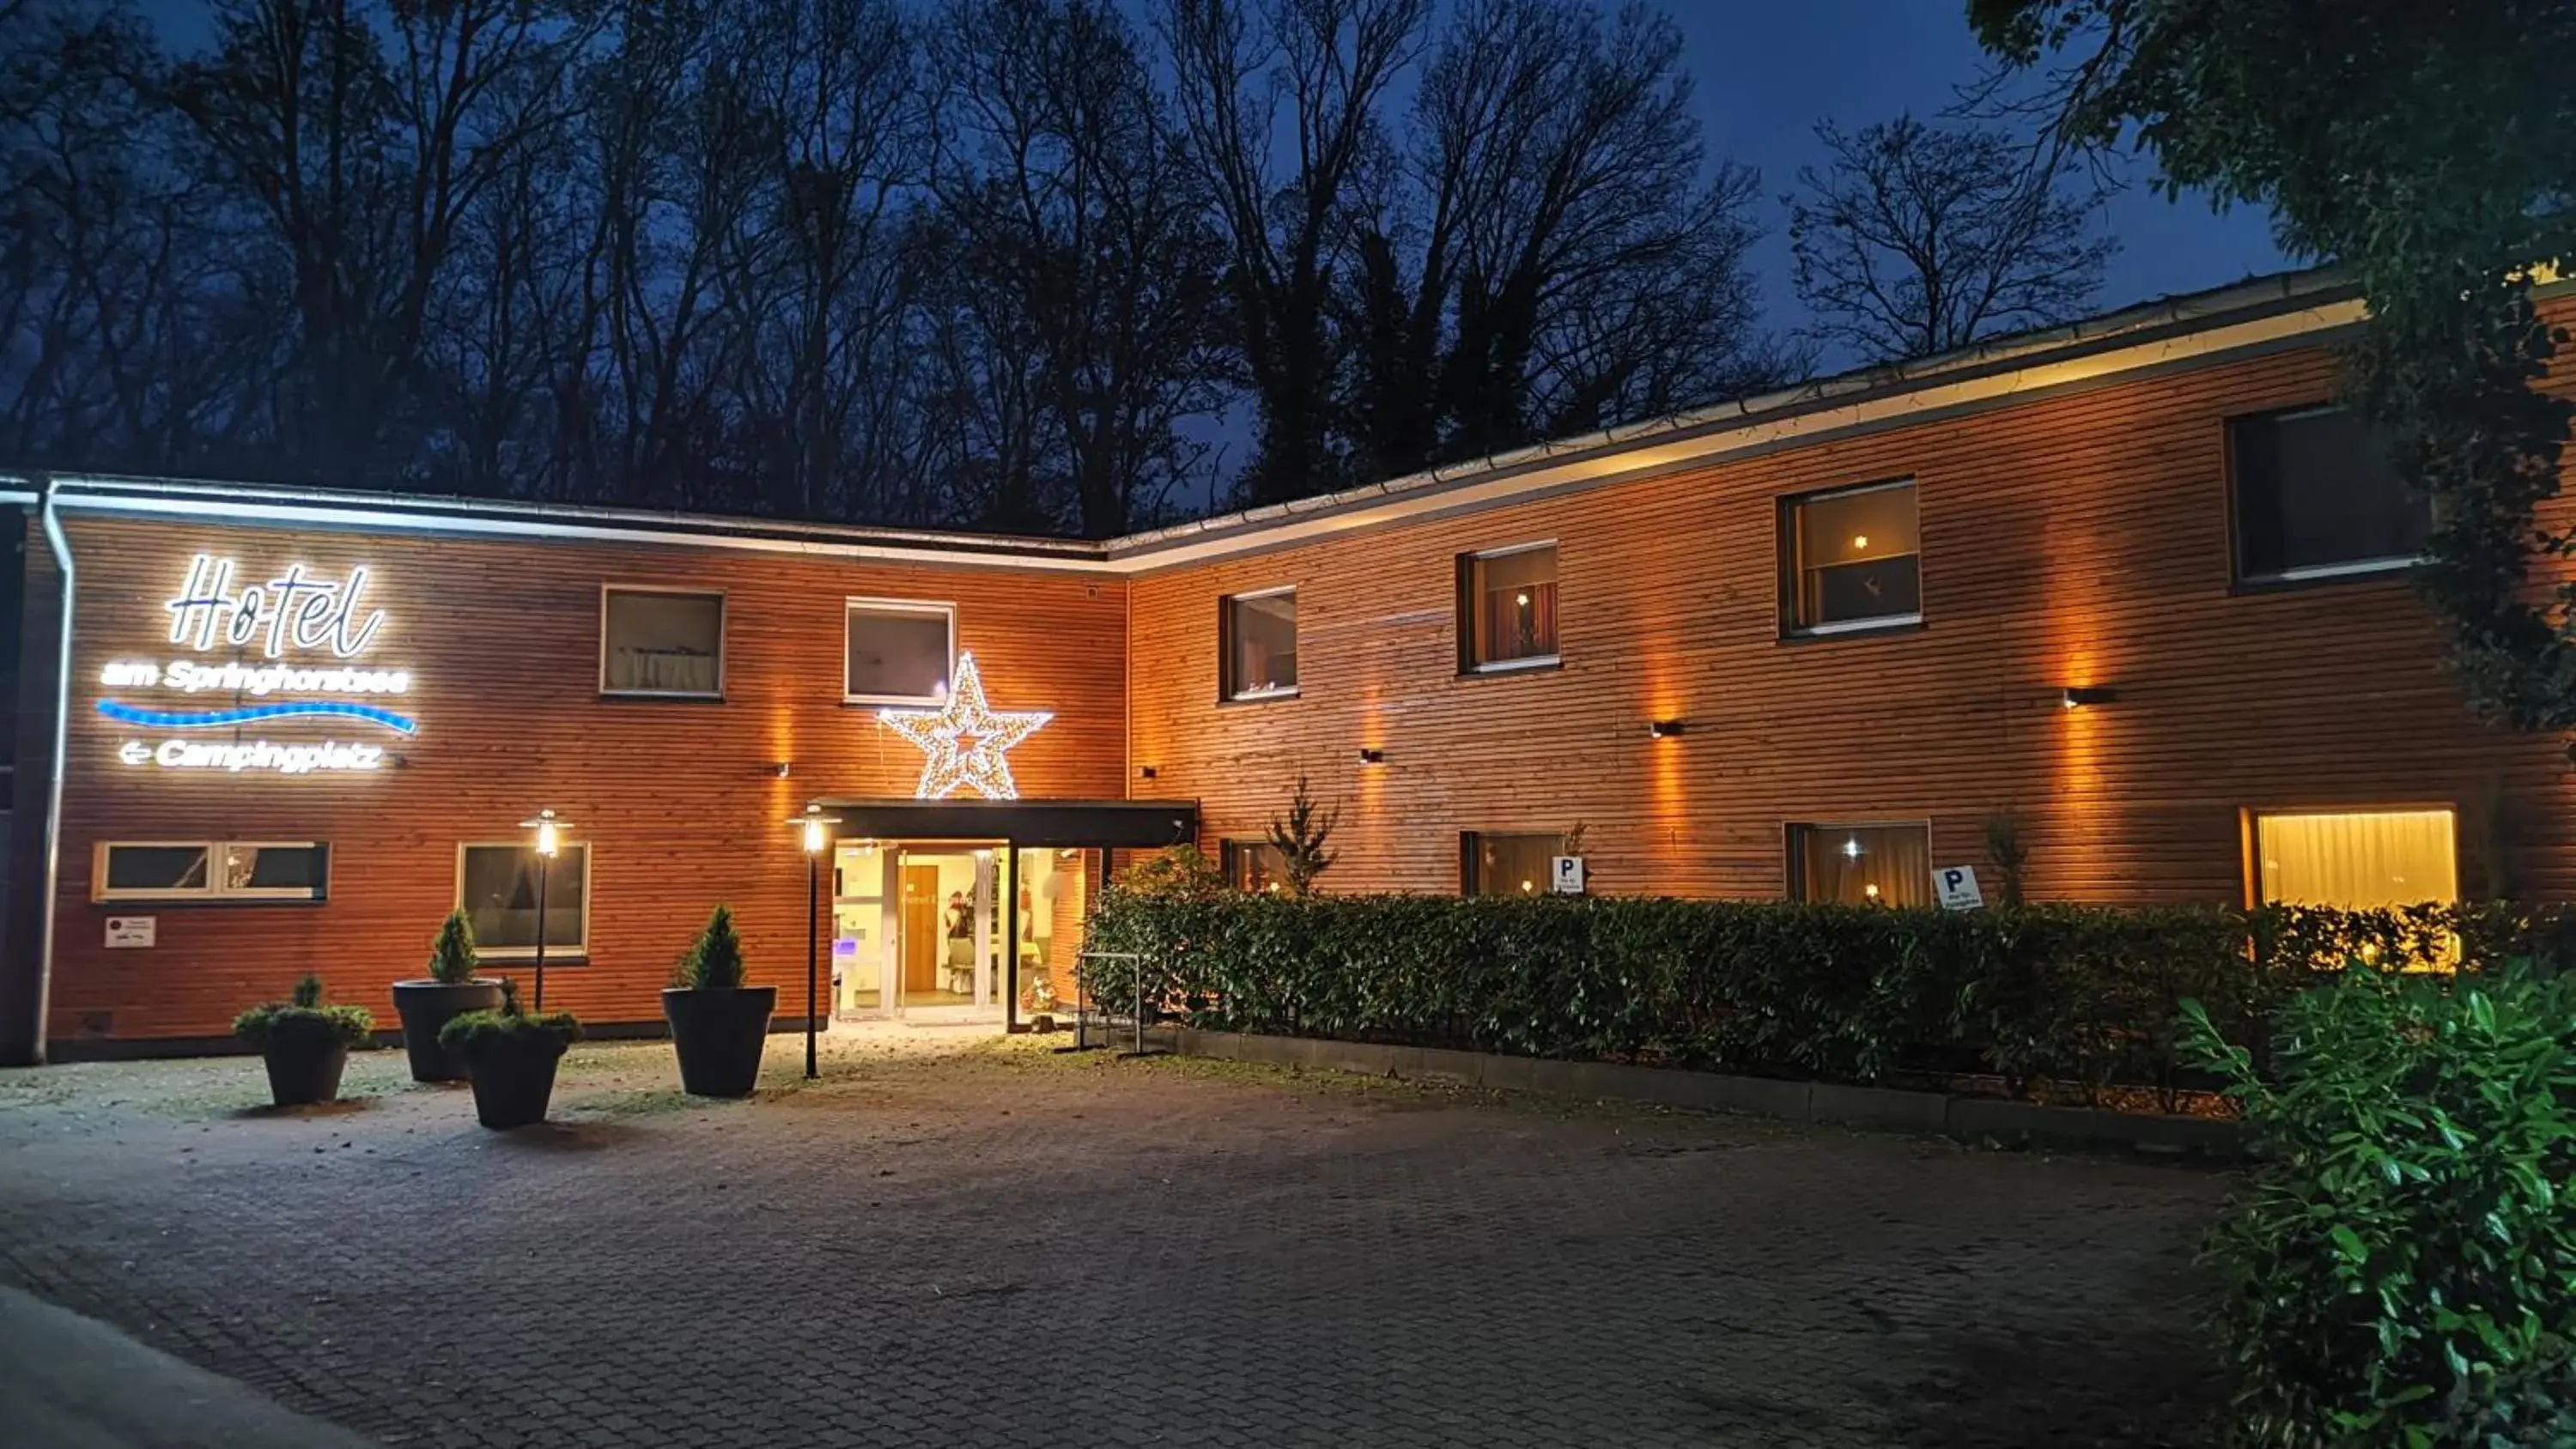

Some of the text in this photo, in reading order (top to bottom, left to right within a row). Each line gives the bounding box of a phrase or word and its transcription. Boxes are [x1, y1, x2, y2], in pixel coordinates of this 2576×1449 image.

[166, 555, 386, 658] Hotel
[100, 663, 160, 686] am
[155, 739, 383, 773] Campingplatz
[1561, 859, 1573, 876] P
[1944, 870, 1963, 892] P
